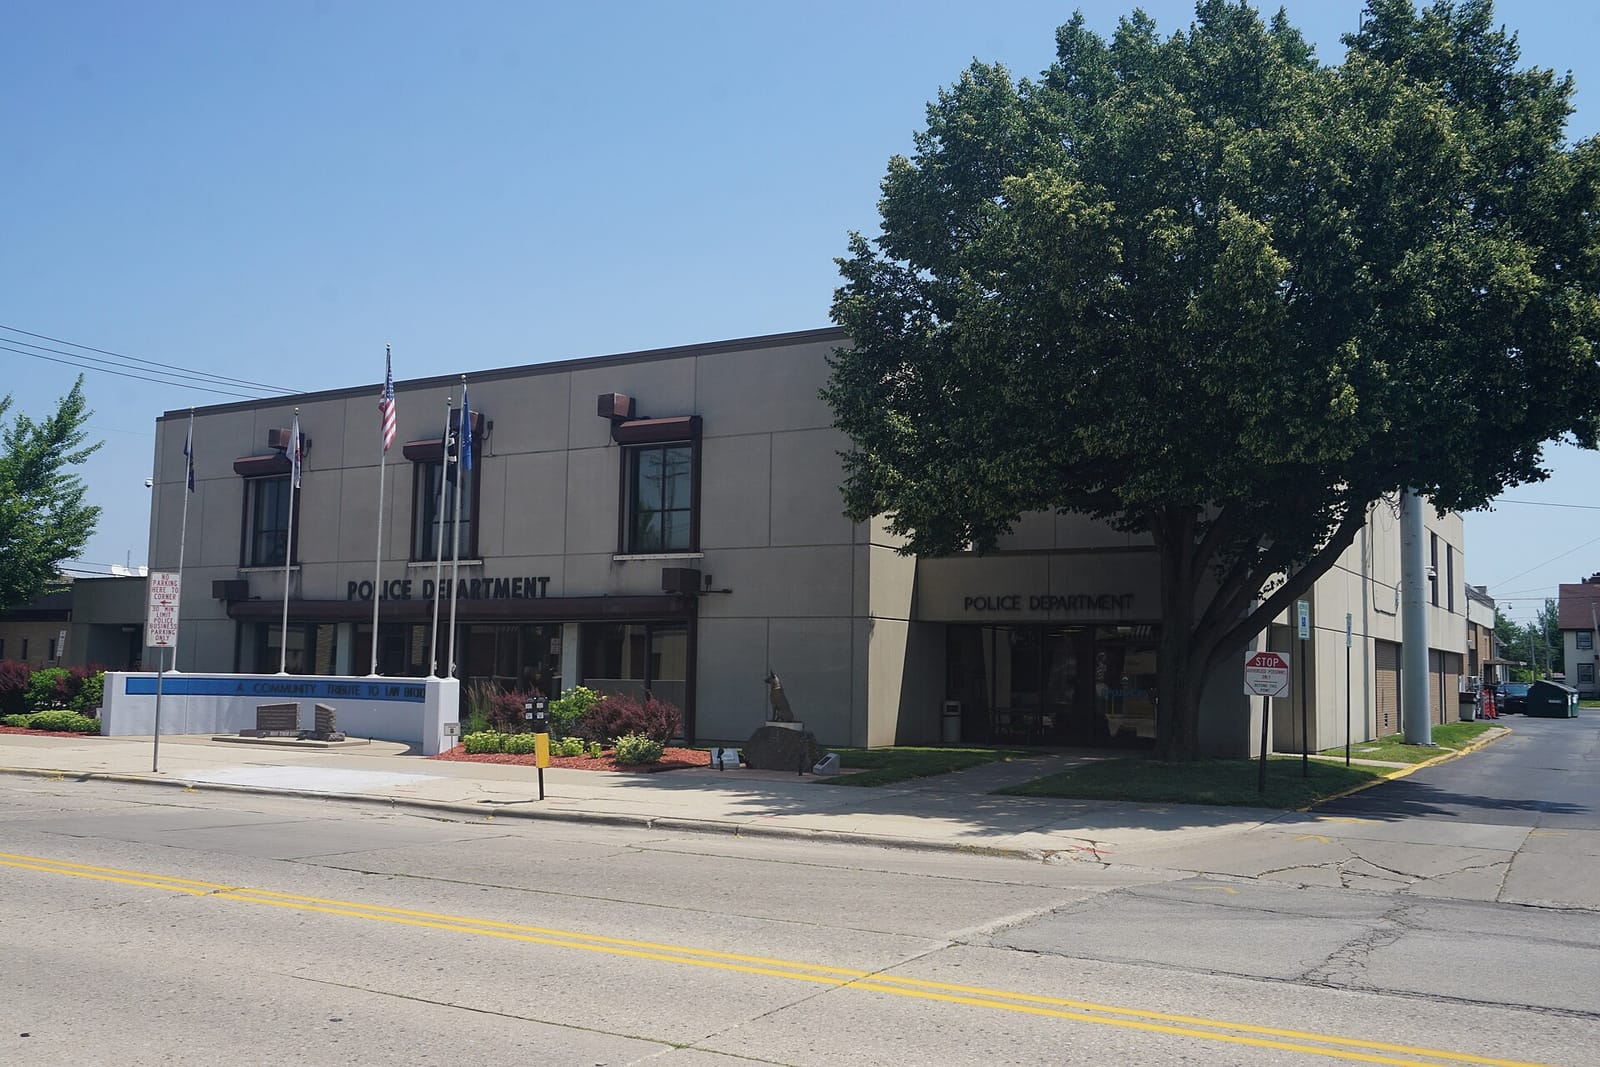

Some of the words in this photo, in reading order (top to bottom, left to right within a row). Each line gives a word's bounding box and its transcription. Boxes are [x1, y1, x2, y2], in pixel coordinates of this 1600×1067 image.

[347, 579, 412, 600] POLICE
[964, 595, 1022, 611] POLICE
[1029, 593, 1134, 610] DEPARTMENT
[1255, 656, 1279, 667] STOP
[236, 682, 245, 693] A
[253, 682, 317, 695] COMMUNITY
[327, 683, 361, 697] TRIBUTE
[367, 685, 380, 697] TO
